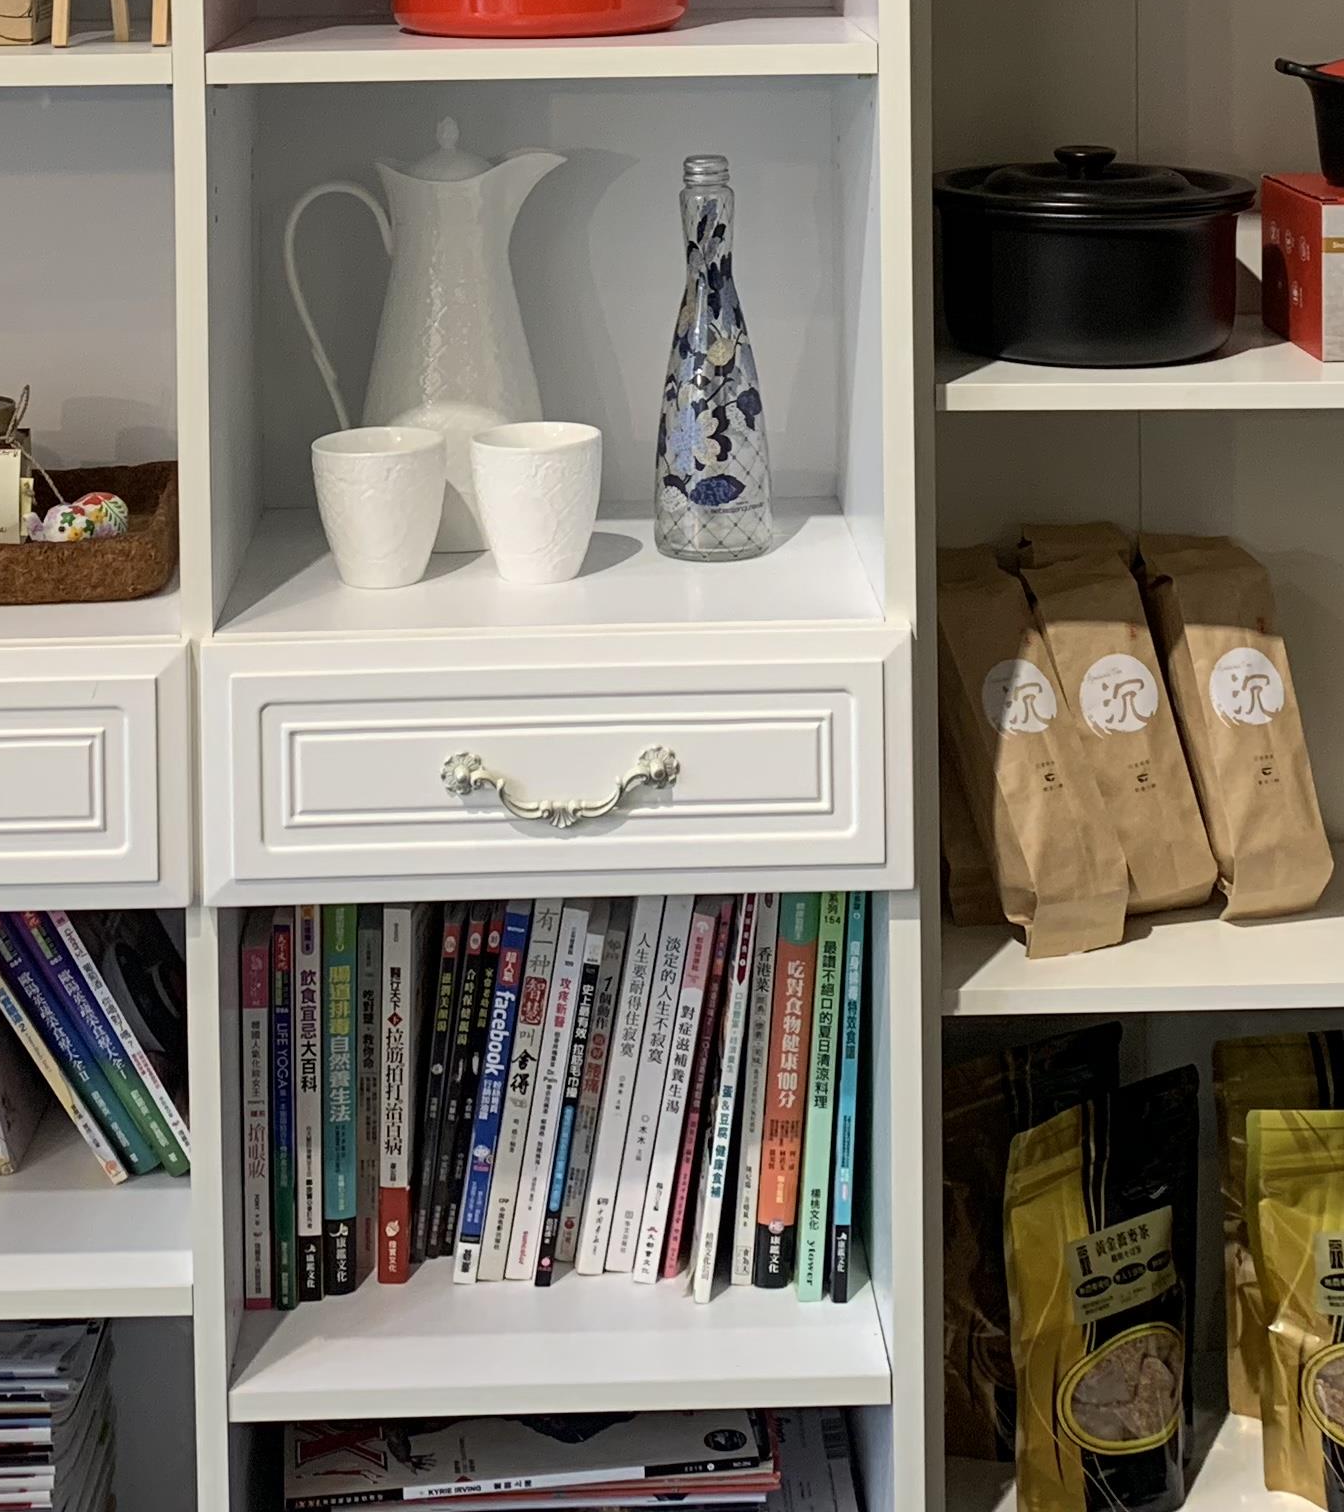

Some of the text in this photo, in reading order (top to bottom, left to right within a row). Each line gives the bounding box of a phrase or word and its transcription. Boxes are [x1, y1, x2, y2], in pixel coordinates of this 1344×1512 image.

[620, 932, 651, 1058] 人生要耐得住寂寞
[648, 935, 682, 1065] 淡定的人生不寂寞
[755, 946, 773, 993] 香港菜
[276, 1049, 289, 1089] YOGA
[300, 969, 318, 1093] 飲食宜忌大百科
[484, 989, 516, 1077] facebook
